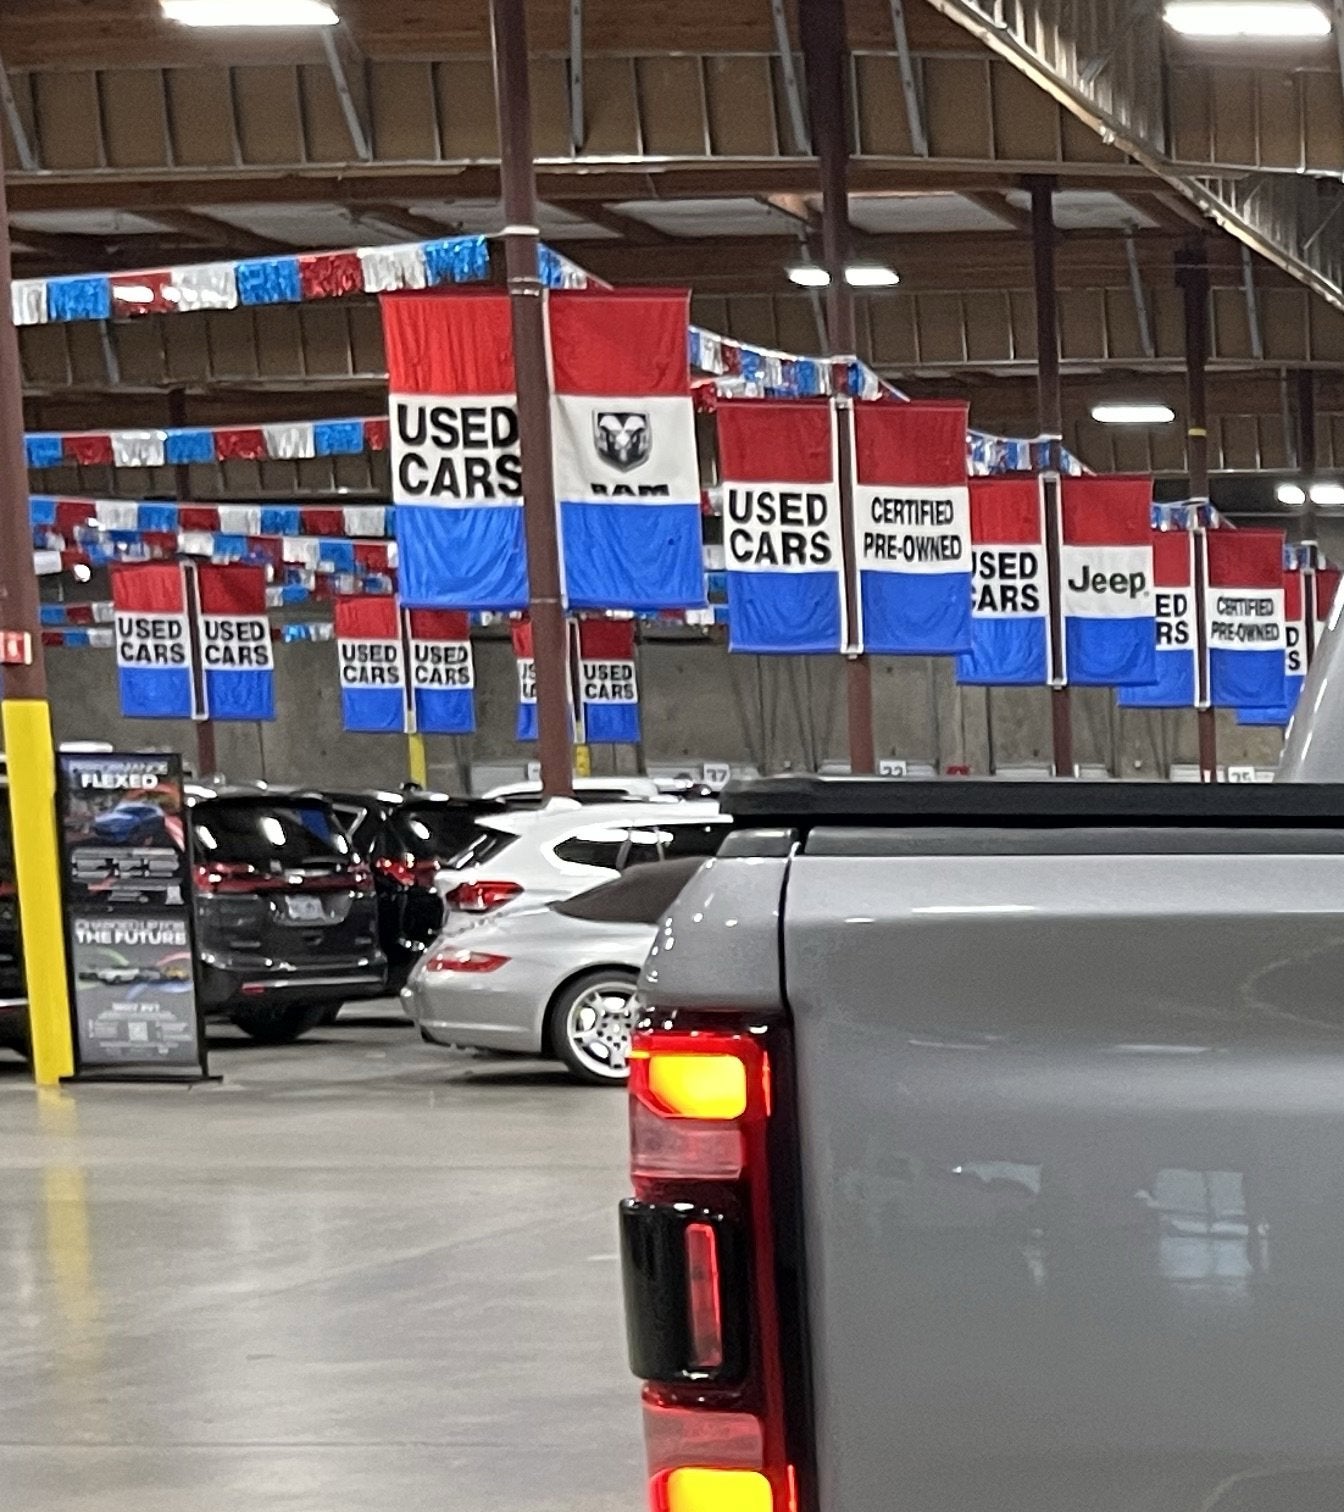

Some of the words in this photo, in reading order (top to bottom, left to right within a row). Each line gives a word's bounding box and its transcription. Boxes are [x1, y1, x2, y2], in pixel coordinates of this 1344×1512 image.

[397, 403, 519, 450] USED
[399, 452, 522, 499] CARS
[590, 483, 670, 496] RAM
[728, 489, 828, 527] USED
[871, 496, 954, 526] CERTIFIED
[730, 528, 832, 566] CARS
[863, 531, 963, 563] PRE-OWNED
[1068, 565, 1146, 599] Jeep
[1155, 593, 1188, 618] ED
[1216, 596, 1275, 617] CERTIFIED
[118, 617, 182, 640] USED
[204, 620, 266, 642] USED
[1156, 620, 1190, 645] RS
[1211, 621, 1280, 643] PRE-OWNED
[121, 642, 186, 664] CARS
[205, 644, 269, 666] CARS
[342, 643, 398, 663] USED
[415, 644, 468, 665] USED
[343, 665, 400, 684] CARS
[415, 665, 470, 686] CARS
[584, 664, 633, 681] USED
[585, 683, 634, 700] CARS
[81, 773, 159, 790] FLEXED
[76, 929, 112, 945] THE
[115, 929, 187, 946] FUTURE
